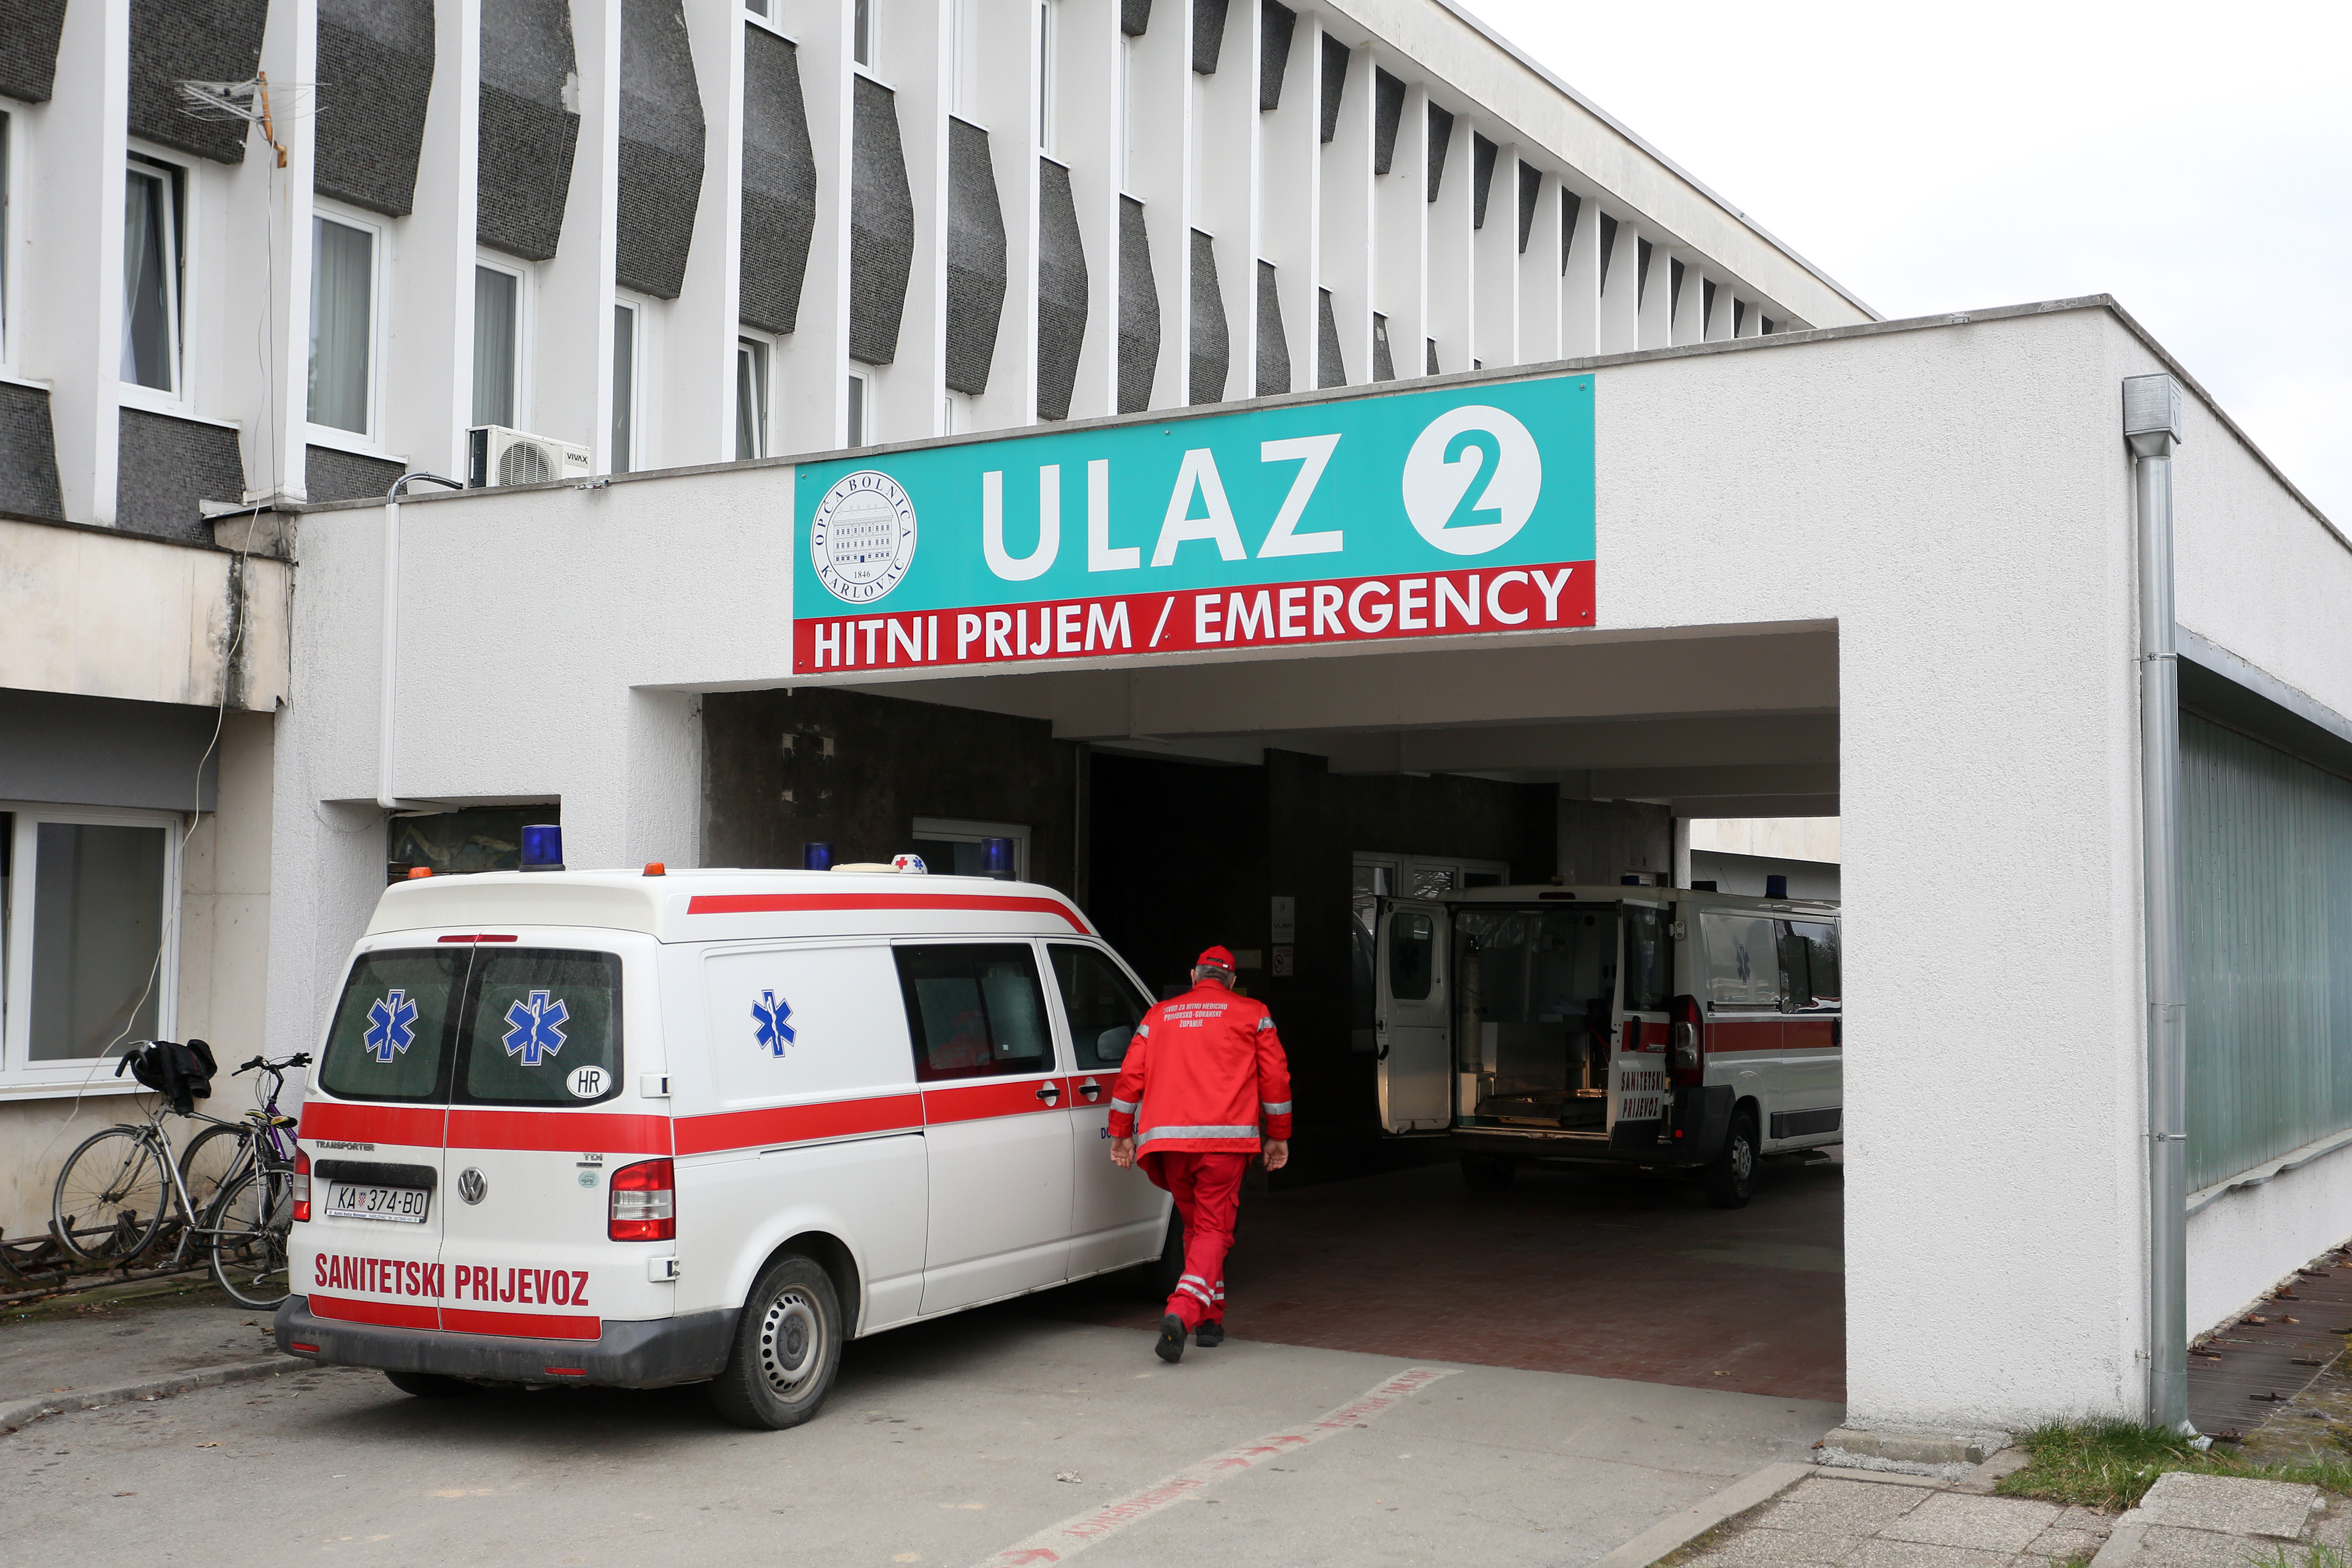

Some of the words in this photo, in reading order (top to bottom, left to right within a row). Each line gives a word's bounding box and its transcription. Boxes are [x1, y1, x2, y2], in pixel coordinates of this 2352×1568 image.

[566, 453, 588, 464] VIVAX
[848, 476, 912, 538] BOLNICA
[983, 433, 1343, 581] ULAZ
[1442, 429, 1502, 530] 2
[821, 558, 904, 598] KARLOVAC
[854, 570, 871, 579] 1846
[814, 615, 937, 667] HITNI
[957, 601, 1132, 660] PRIJEM
[1149, 596, 1175, 647] /
[1195, 568, 1573, 644] EMERGENCY
[1163, 1005, 1178, 1014] ZAVOD
[1180, 1019, 1204, 1028] ŽUPANIJE
[578, 1070, 600, 1093] HR
[1621, 1071, 1664, 1092] SANITETSKI
[1622, 1097, 1659, 1118] PRIJEVOZ
[315, 1141, 375, 1152] TRANSPORTER
[583, 1153, 603, 1161] TDI
[338, 1187, 356, 1209] KA
[315, 1253, 445, 1298] SANITETSKI
[455, 1265, 589, 1306] PRIJEVOZ
